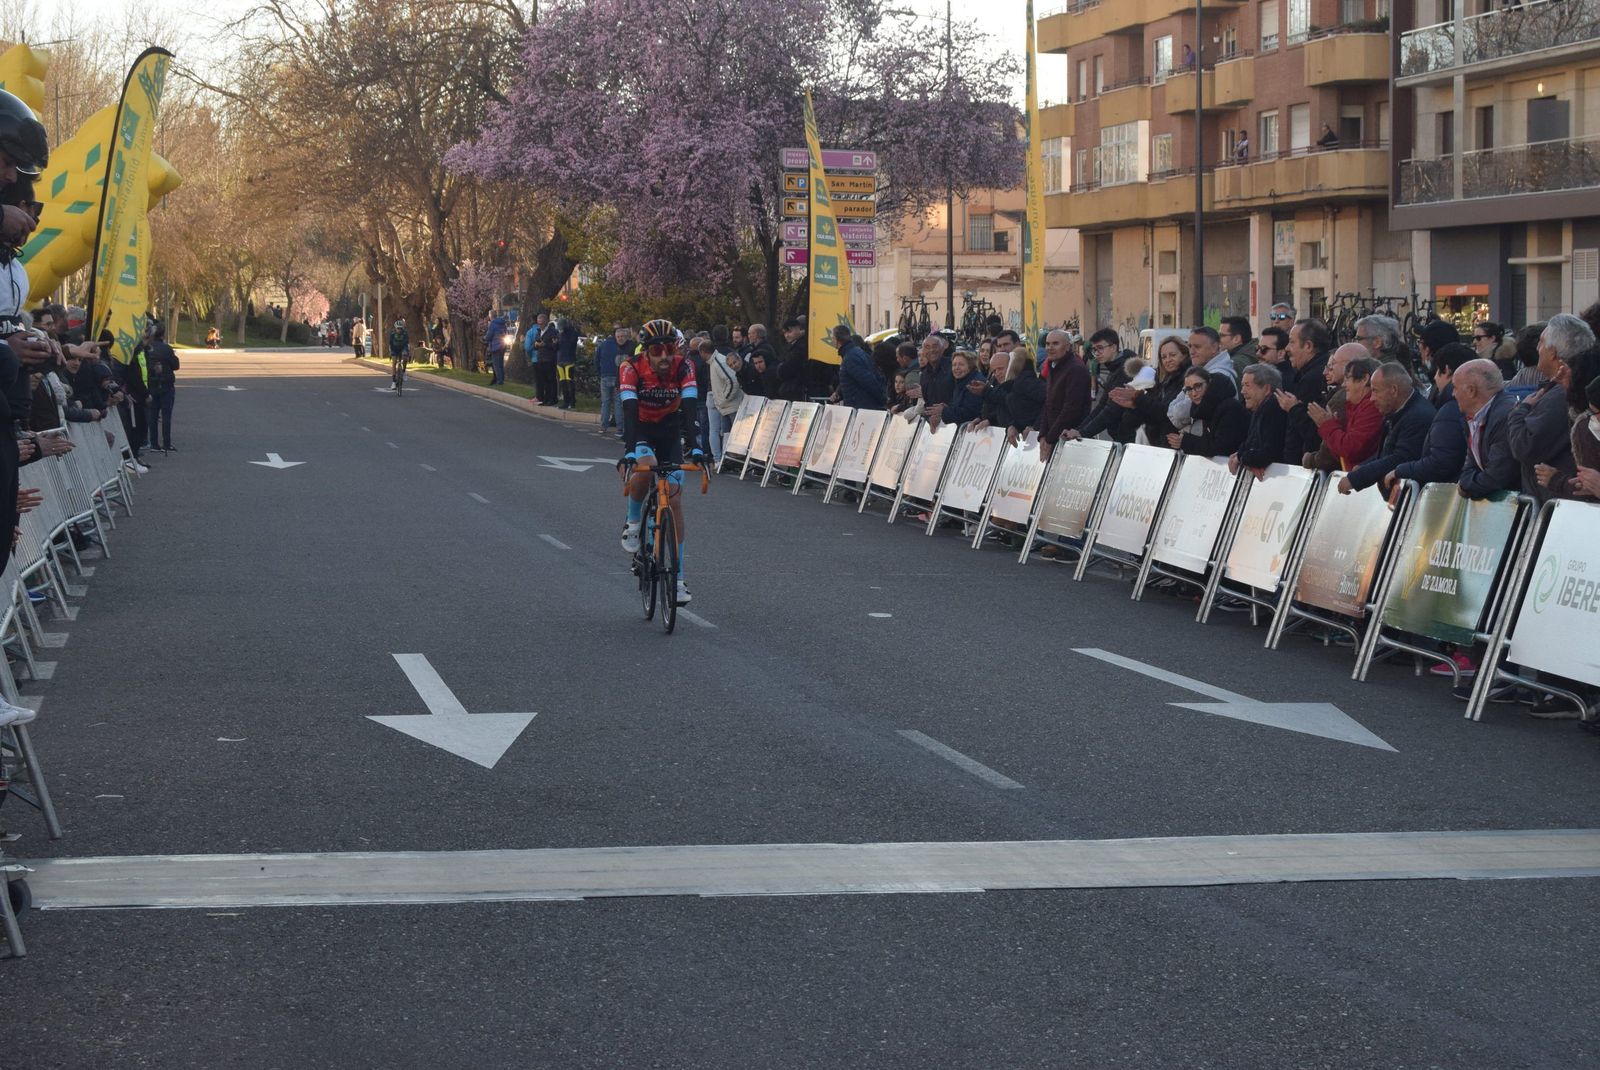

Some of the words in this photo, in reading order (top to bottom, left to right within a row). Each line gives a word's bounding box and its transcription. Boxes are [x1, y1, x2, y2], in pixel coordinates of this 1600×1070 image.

[1429, 540, 1452, 568] CAJA
[1451, 542, 1496, 576] RURAL
[1567, 559, 1586, 573] GRUPO
[1421, 574, 1431, 591] DE
[1429, 575, 1458, 595] ZAMORA
[1557, 575, 1600, 613] IBERE
